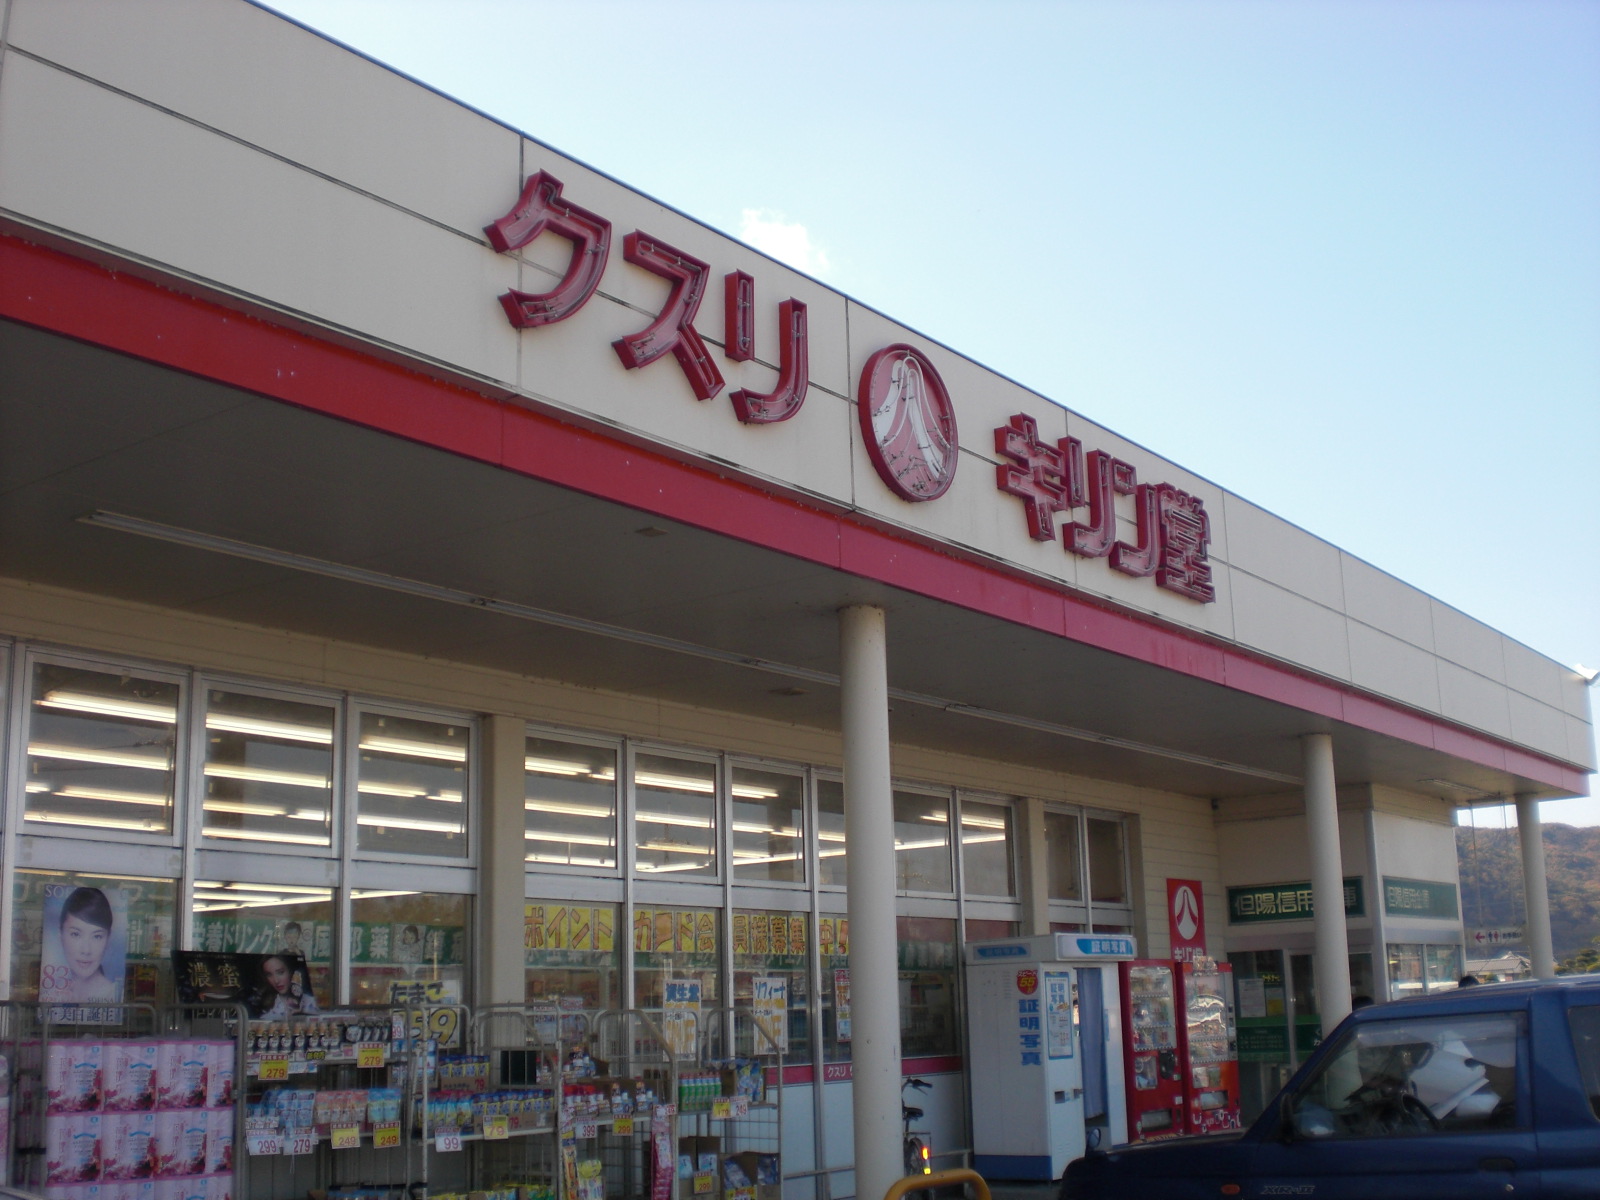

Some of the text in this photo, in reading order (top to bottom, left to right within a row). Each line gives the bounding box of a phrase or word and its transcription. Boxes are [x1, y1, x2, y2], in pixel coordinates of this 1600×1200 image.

[482, 168, 809, 425] クスリ
[994, 412, 1217, 604] キリン堂
[1018, 999, 1042, 1067] 証明写真
[364, 1056, 381, 1066] 279
[266, 1068, 285, 1078] 279
[828, 1065, 847, 1078] クスリ
[489, 1125, 504, 1136] 79
[582, 1125, 595, 1137] 399
[258, 1139, 277, 1154] 299
[293, 1138, 311, 1153] 279
[339, 1136, 357, 1146] 249
[380, 1135, 397, 1146] 249
[444, 1136, 459, 1150] 99
